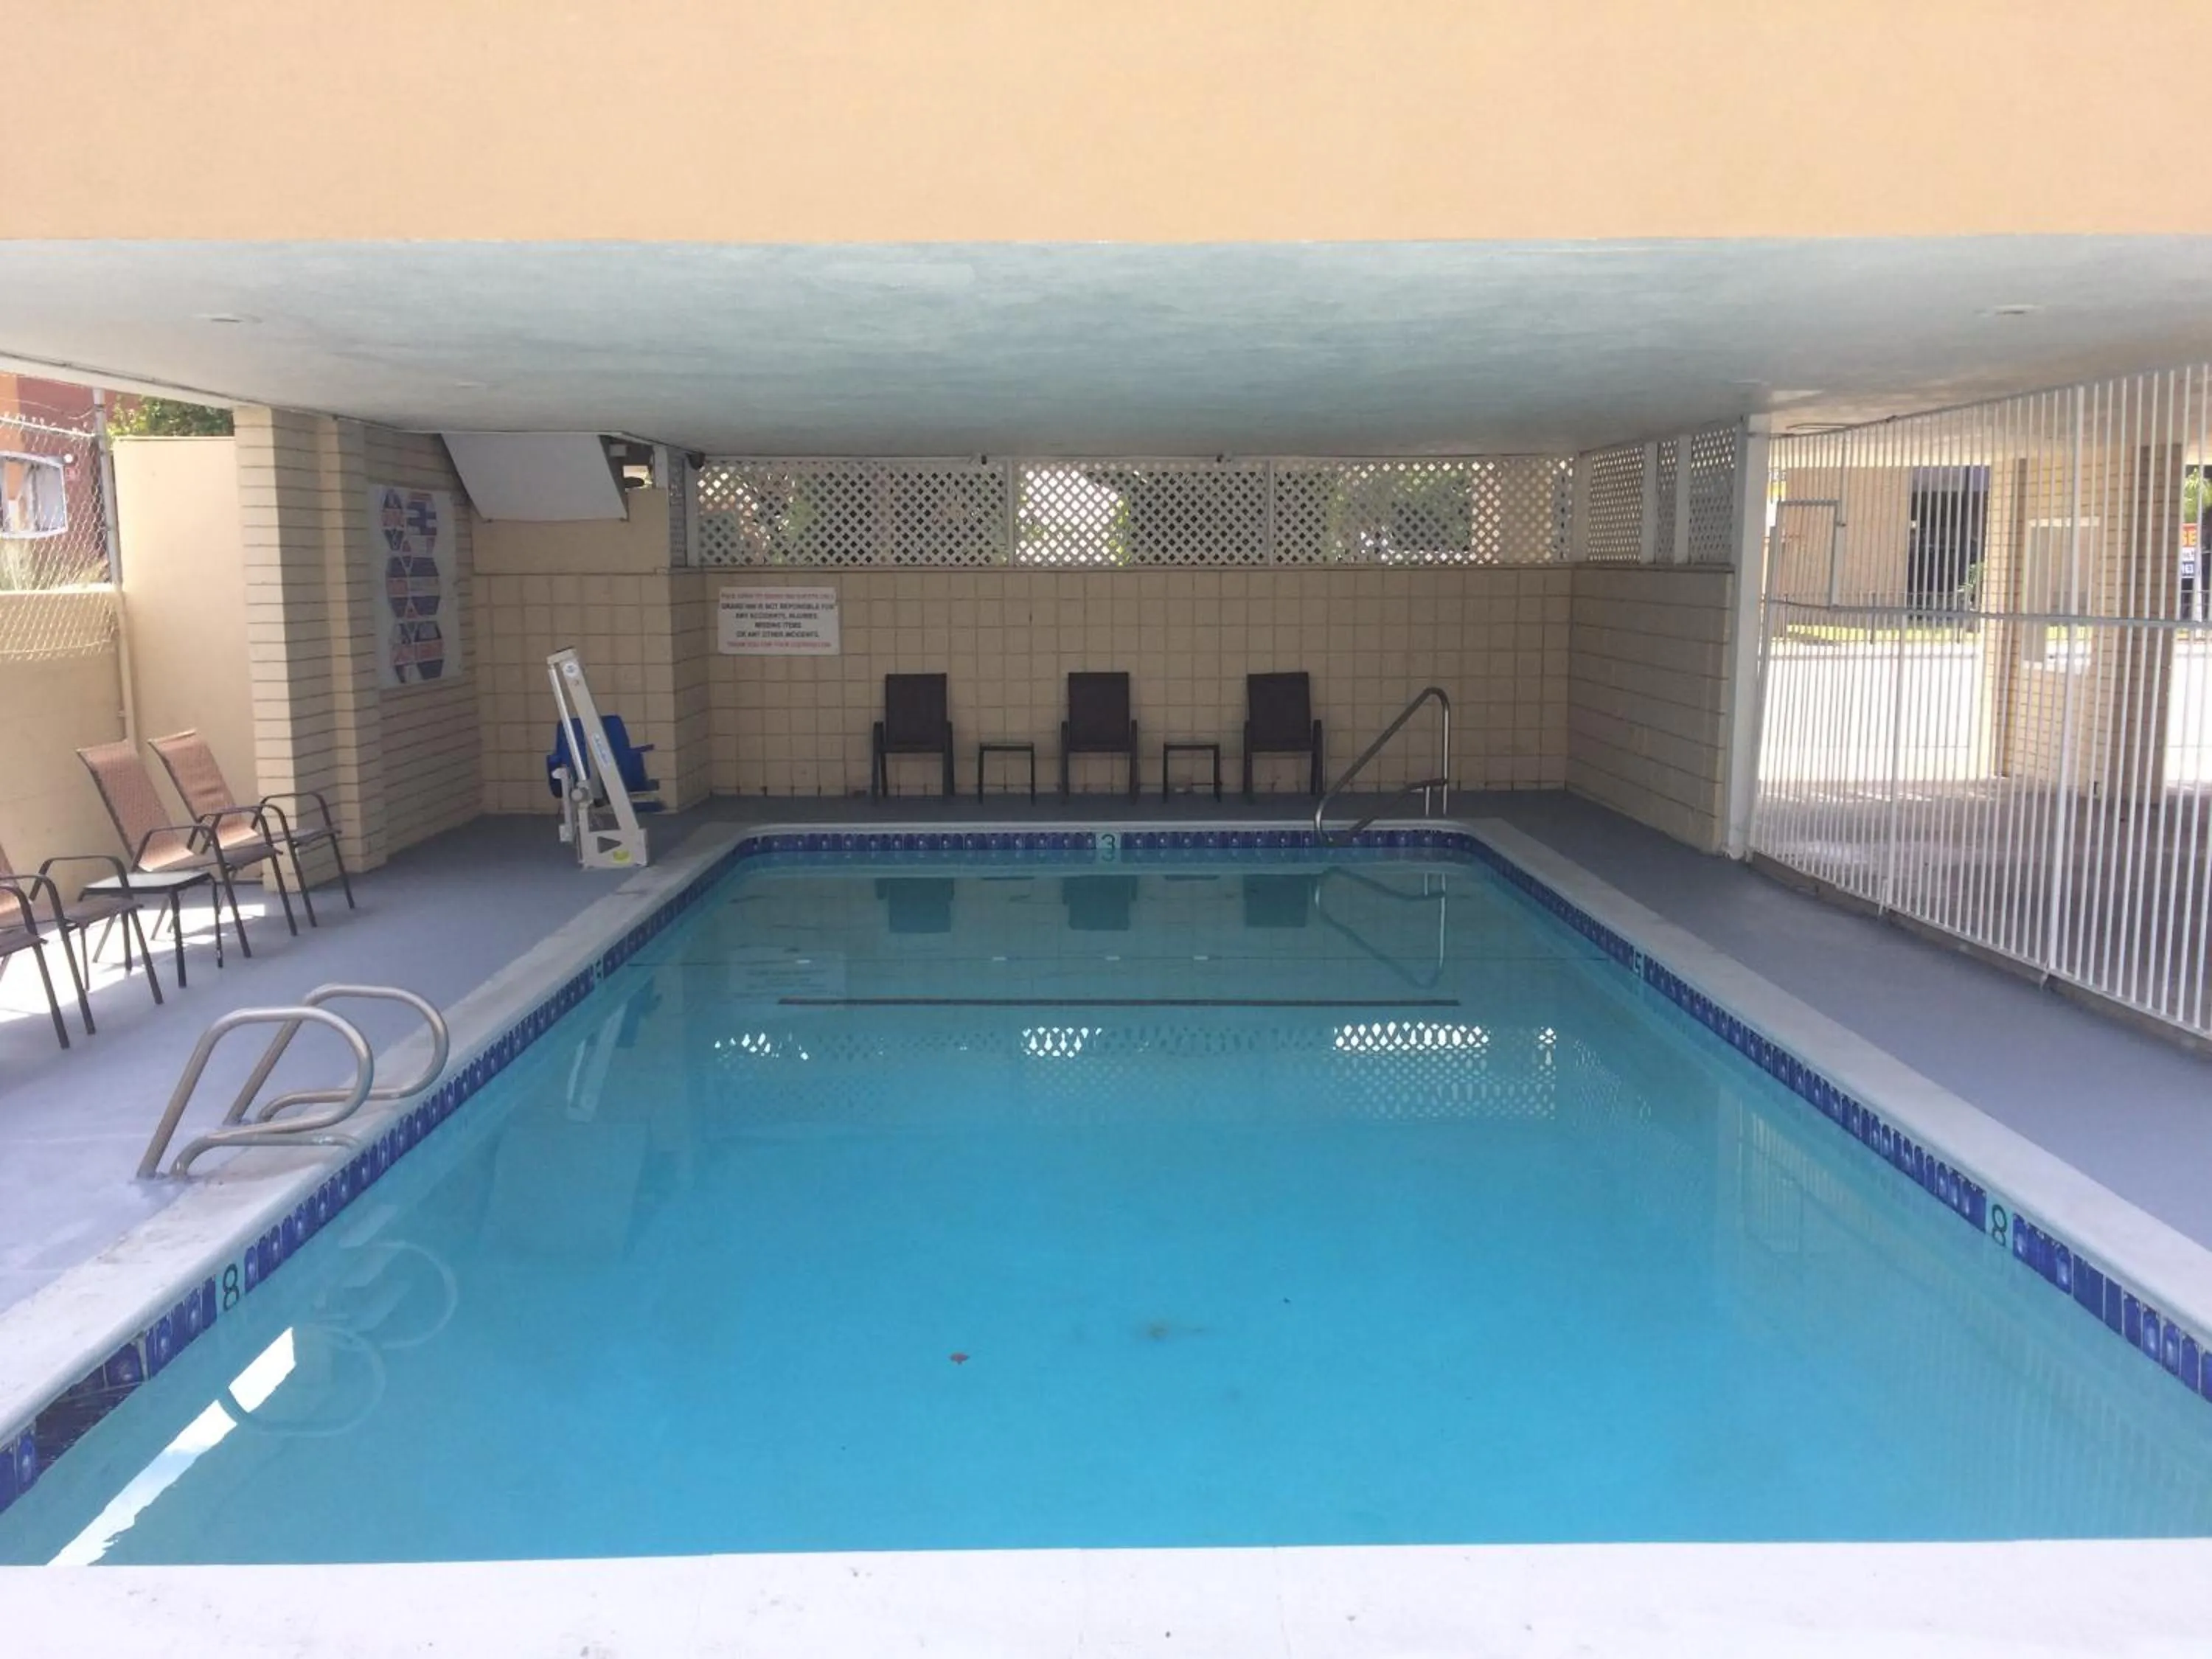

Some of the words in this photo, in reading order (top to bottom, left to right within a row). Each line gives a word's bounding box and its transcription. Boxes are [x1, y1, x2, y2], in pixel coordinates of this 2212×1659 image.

[1101, 833, 1116, 849] 3
[1992, 1204, 2007, 1247] 8
[223, 1263, 240, 1312] 8
